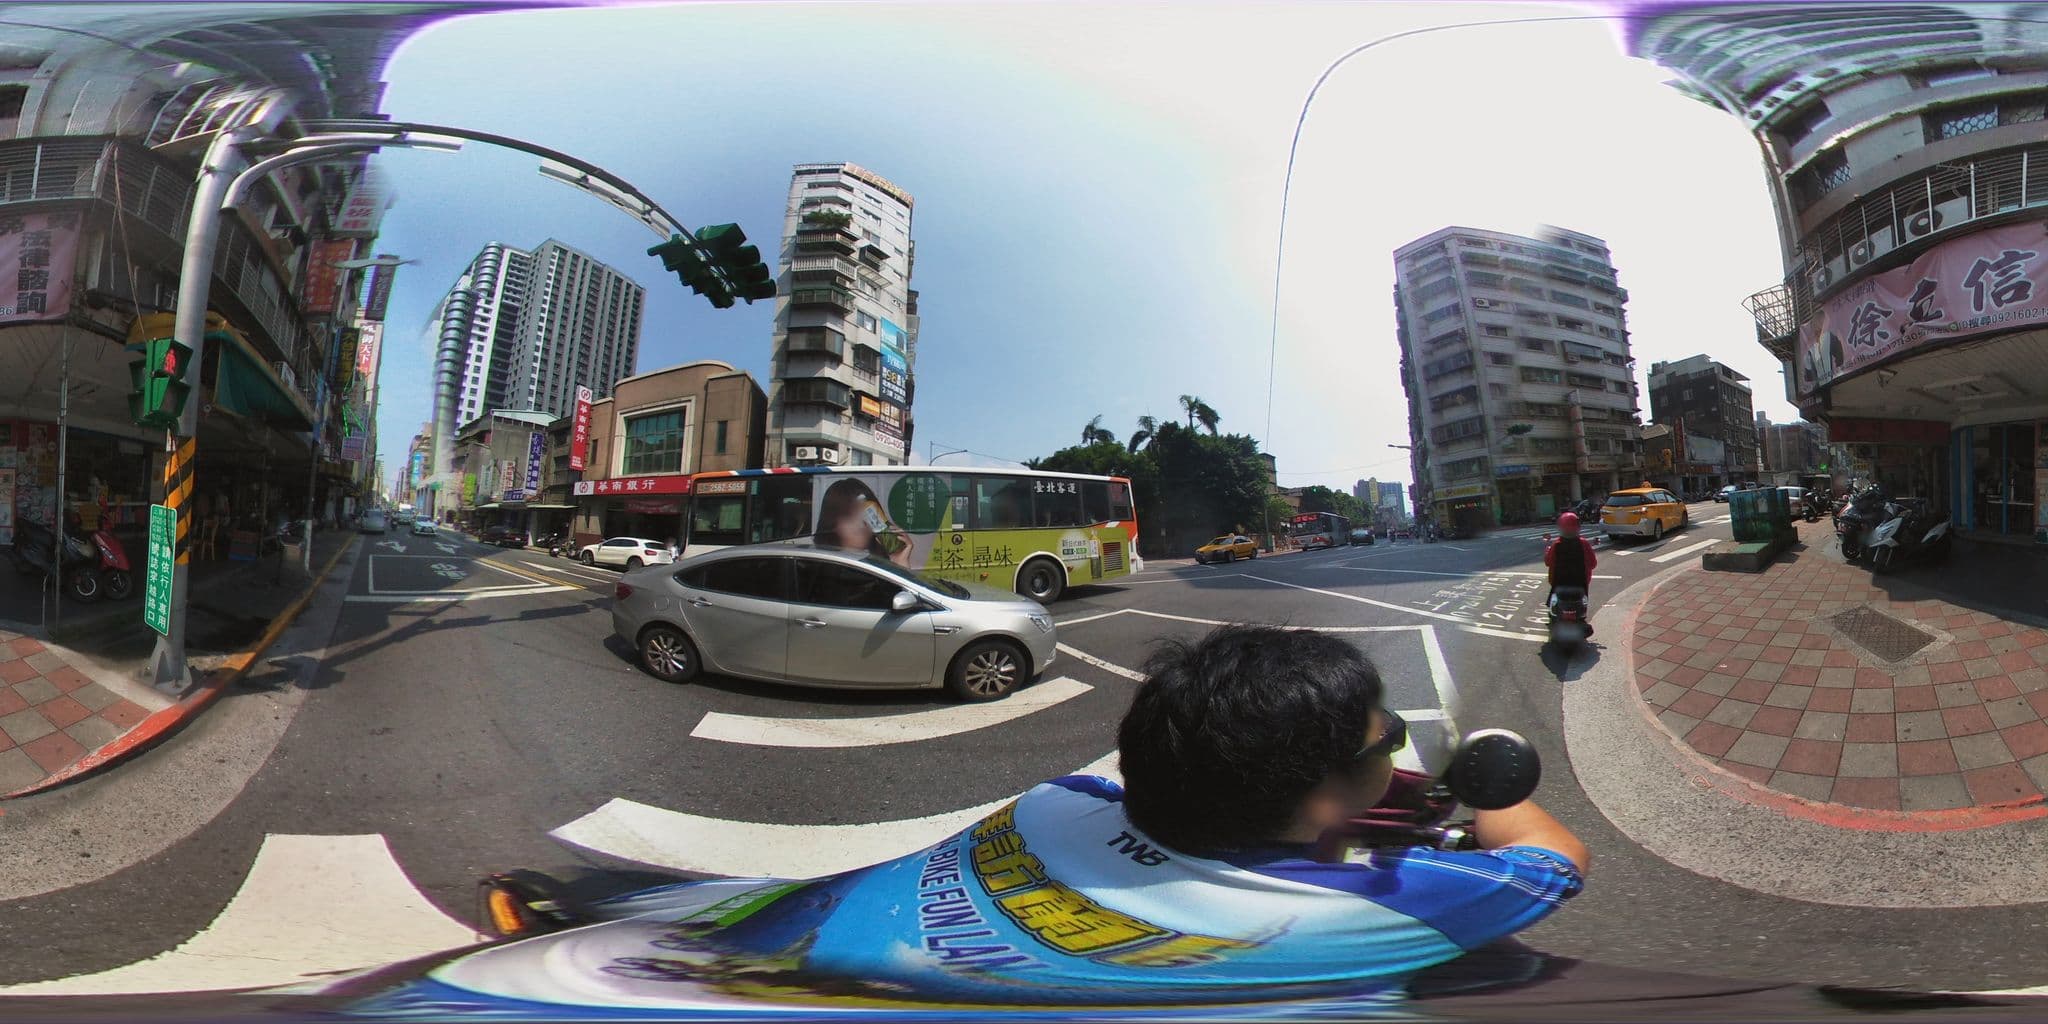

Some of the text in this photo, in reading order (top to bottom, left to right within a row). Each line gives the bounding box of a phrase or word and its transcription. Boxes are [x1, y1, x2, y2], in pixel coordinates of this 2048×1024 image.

[576, 404, 588, 442] 華南銀行
[598, 479, 656, 492] 華南銀行
[1034, 481, 1077, 493] 臺北客運
[157, 545, 172, 629] 請依行人專用
[921, 847, 961, 888] BIKE
[1107, 831, 1171, 866] TWB
[920, 887, 983, 930] FUN
